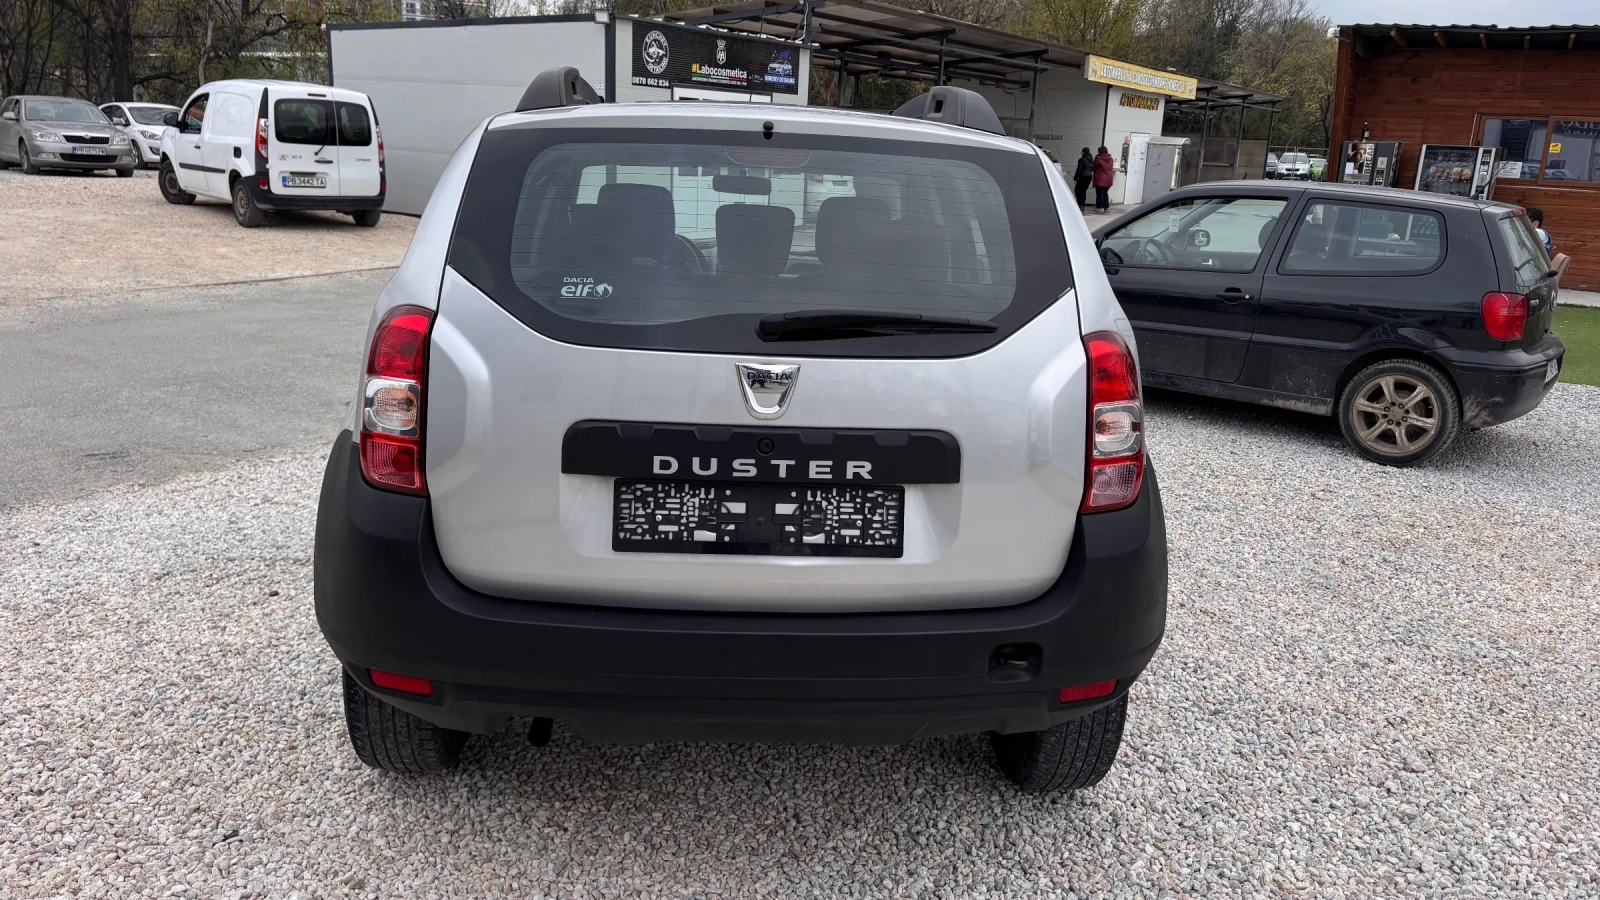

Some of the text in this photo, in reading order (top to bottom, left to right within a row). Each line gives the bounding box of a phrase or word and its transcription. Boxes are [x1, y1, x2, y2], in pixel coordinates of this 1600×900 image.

[691, 63, 748, 79] #Labocosmetica
[632, 76, 646, 84] 0878
[1363, 143, 1376, 174] BREAK
[297, 177, 315, 186] 3442
[316, 178, 325, 186] TA
[561, 284, 594, 297] elf
[746, 371, 790, 381] DACIA
[652, 455, 873, 480] DUSTER
